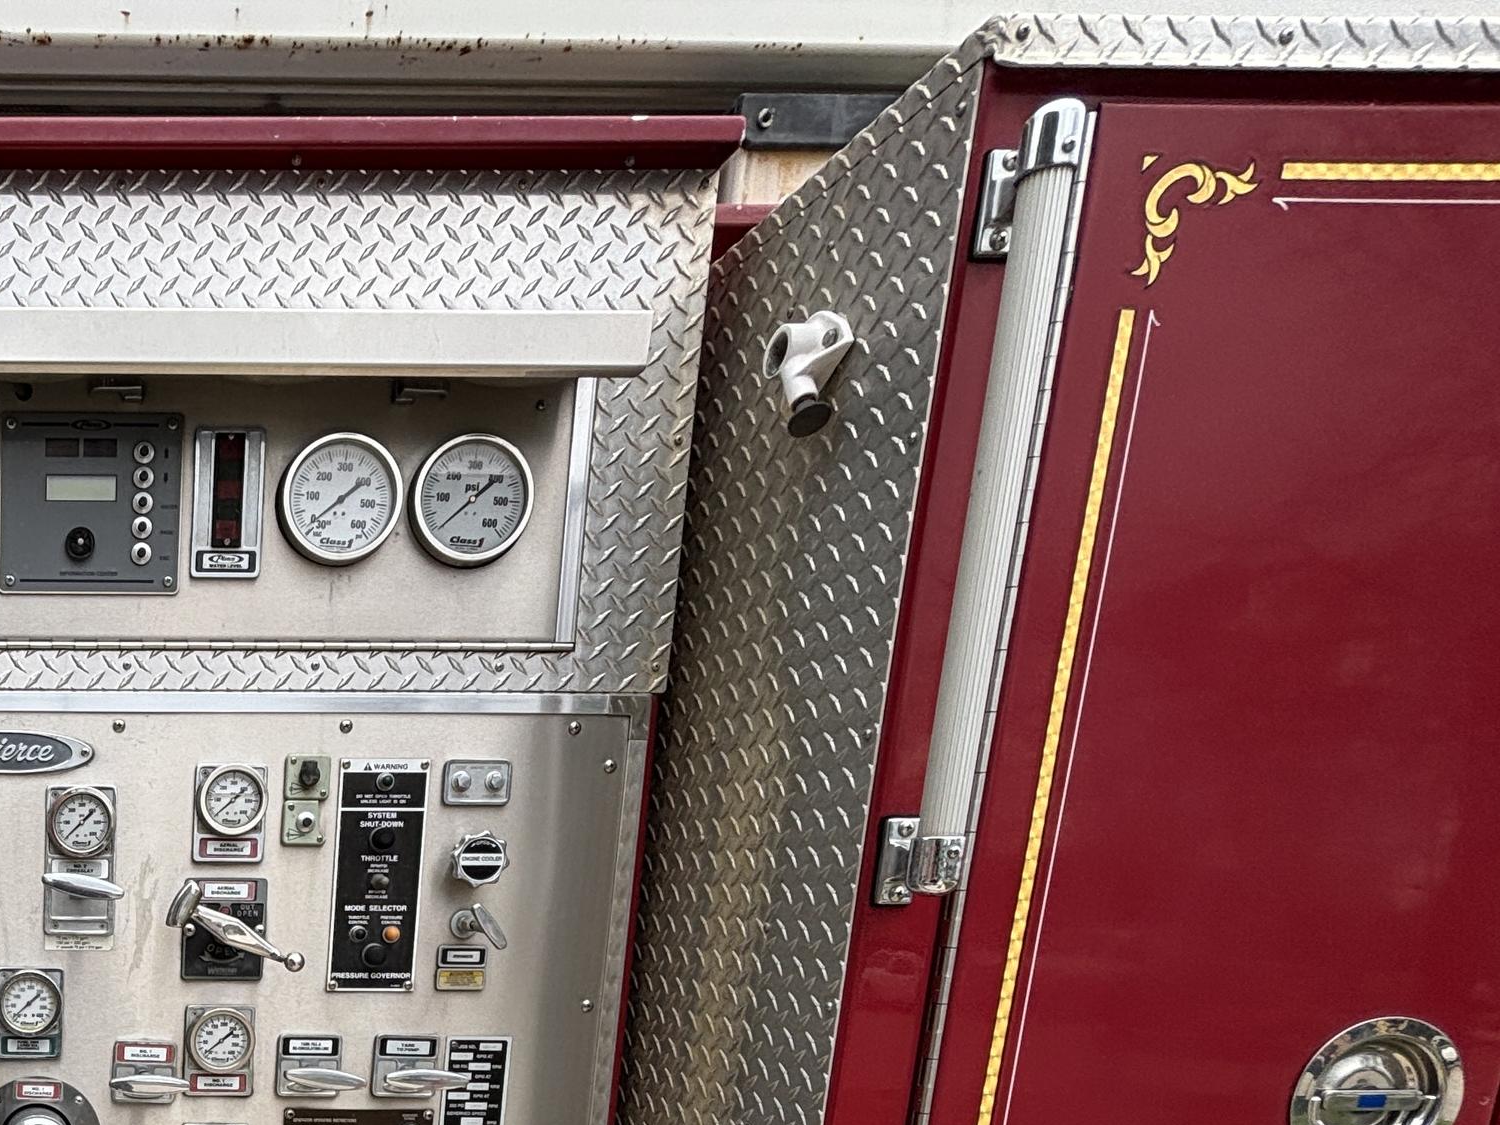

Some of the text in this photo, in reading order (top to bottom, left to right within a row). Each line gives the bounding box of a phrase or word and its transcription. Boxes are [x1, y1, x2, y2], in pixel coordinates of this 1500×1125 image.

[337, 462, 353, 472] 300
[468, 461, 483, 470] 300
[316, 472, 332, 481] 200
[446, 472, 461, 480] 200
[465, 482, 480, 493] psi
[306, 491, 319, 500] 100
[436, 492, 450, 502] 100
[360, 499, 375, 508] 500
[493, 496, 508, 506] 500
[351, 520, 366, 529] 600
[482, 519, 497, 528] 600
[360, 820, 404, 828] SHUT-DOWN
